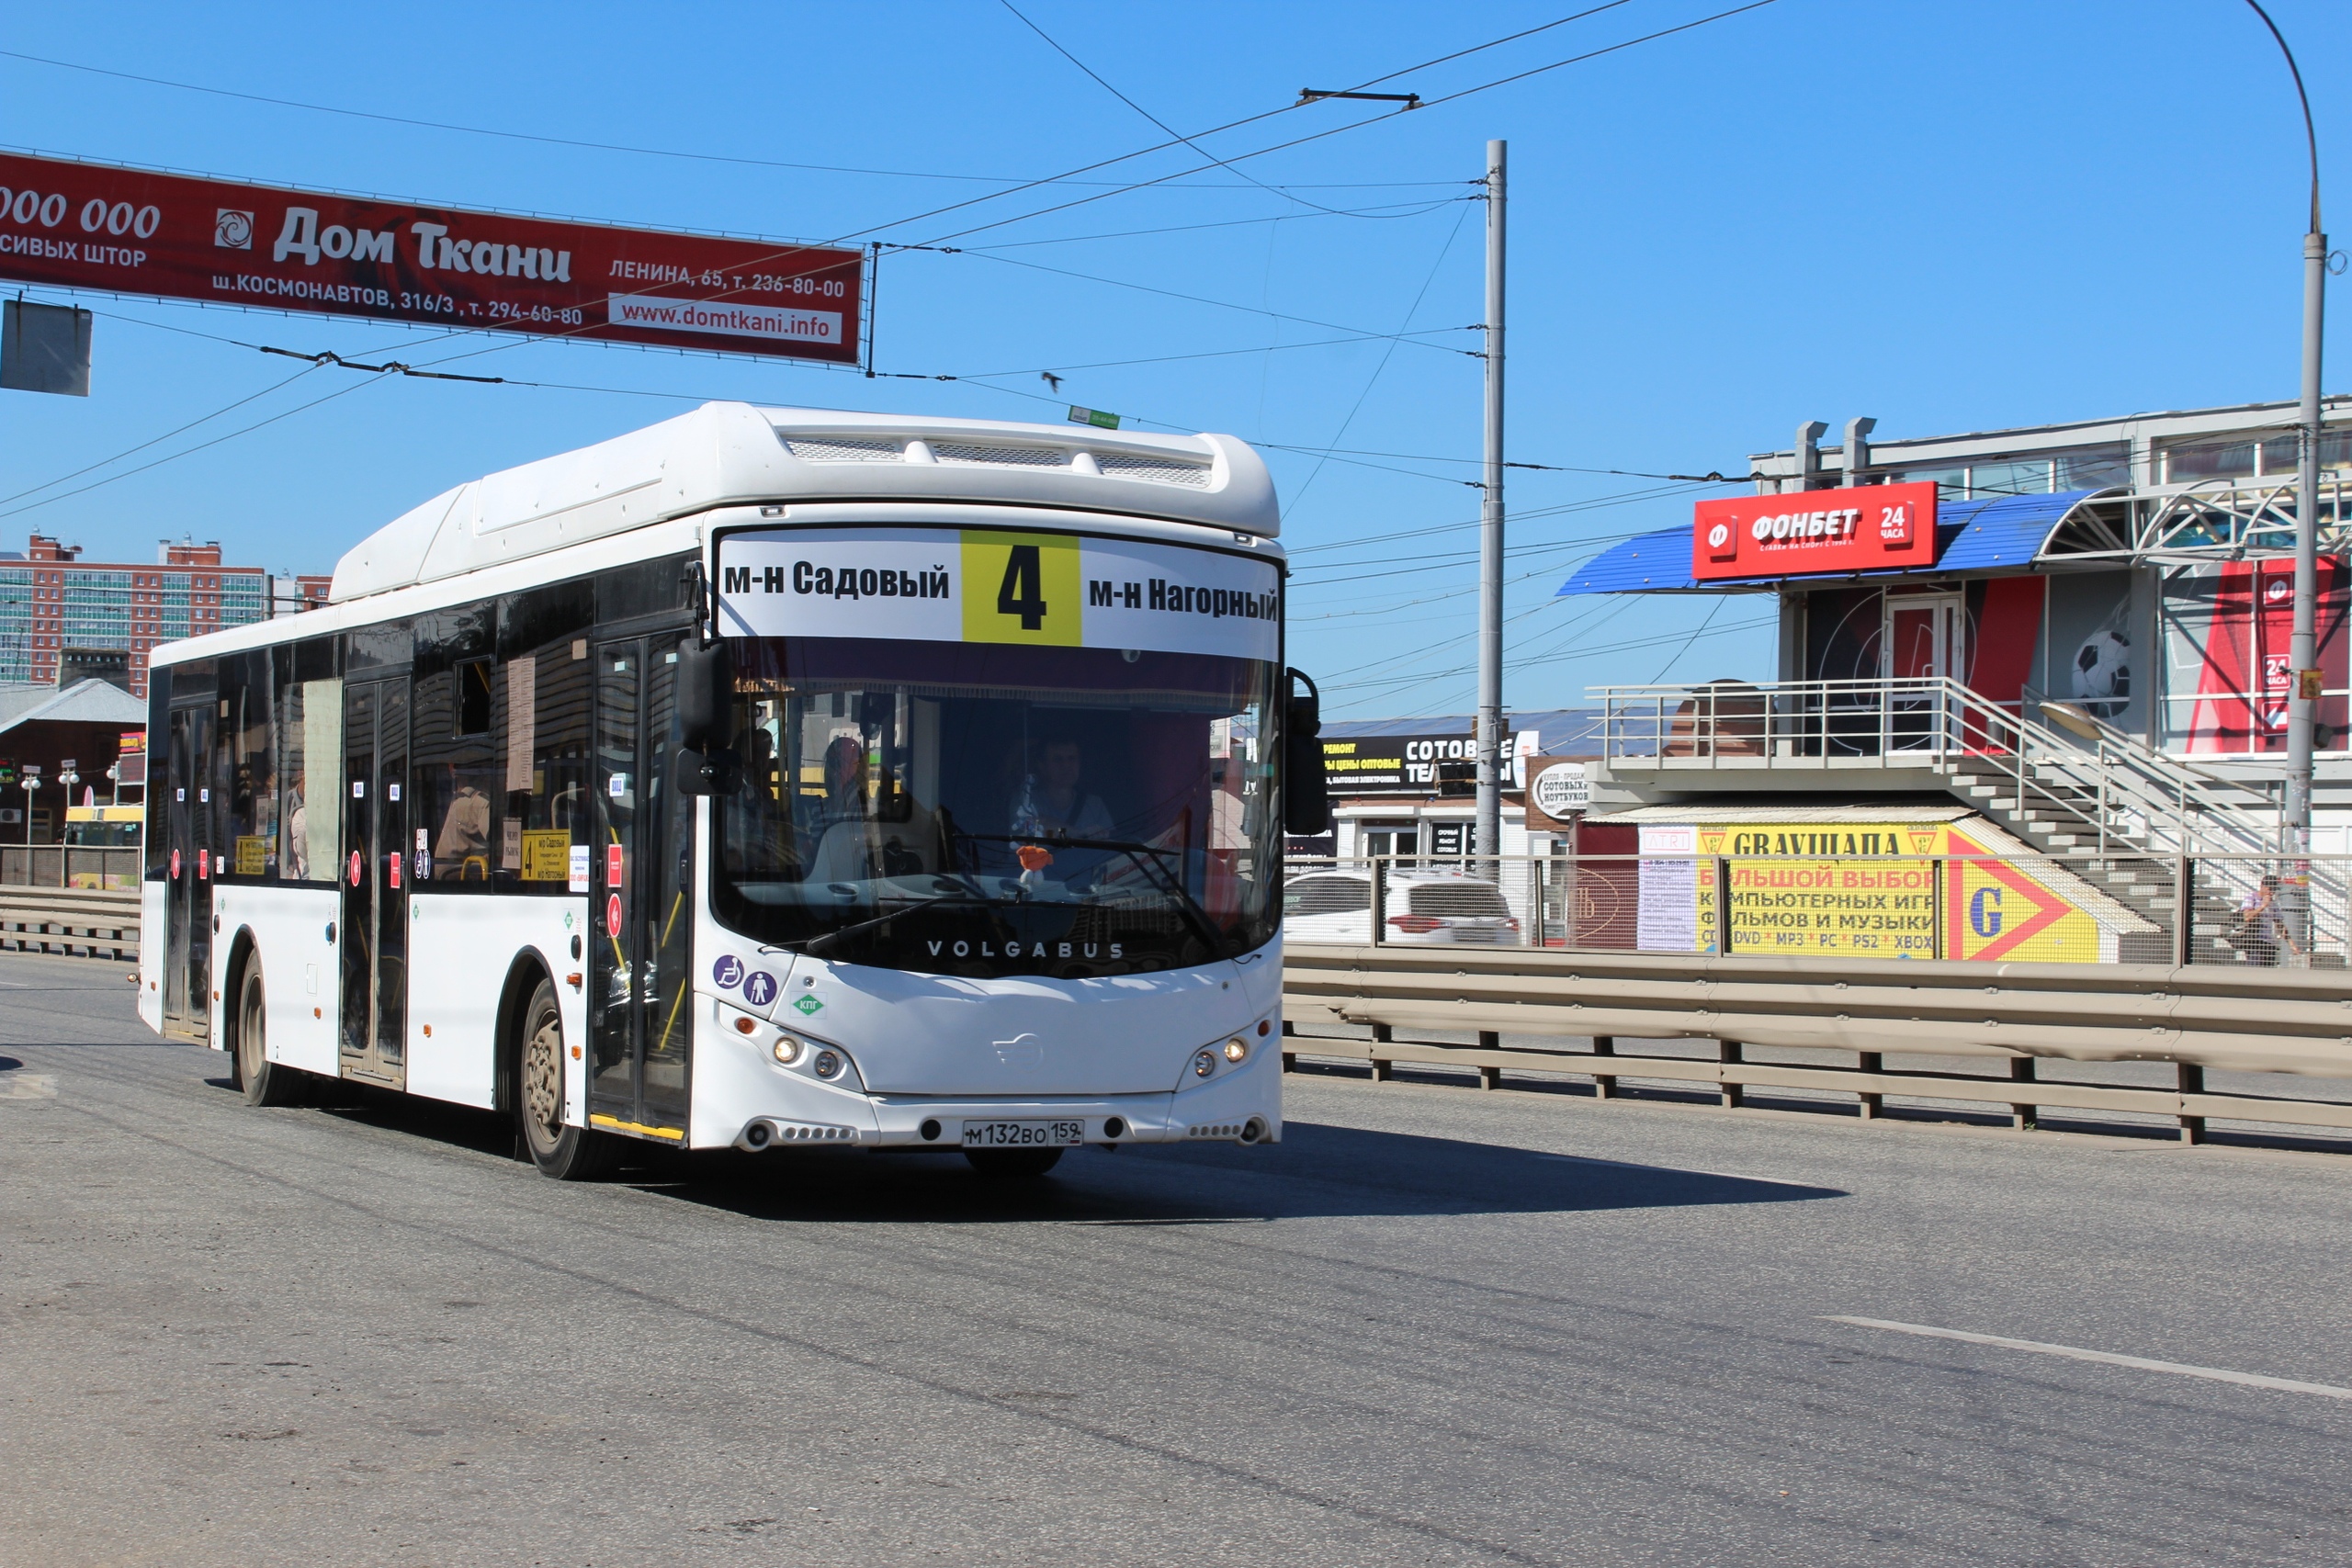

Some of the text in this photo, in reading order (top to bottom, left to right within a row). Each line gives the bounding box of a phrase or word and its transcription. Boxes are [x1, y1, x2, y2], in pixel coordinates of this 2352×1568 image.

[80, 198, 161, 239] 000
[0, 234, 146, 267] СИВЫХ ШТОР
[273, 207, 571, 283] Дом Ткани
[609, 260, 844, 298] ЛЕНИНА, 65, т. 236-80-00
[212, 275, 395, 310] ш.КОСМОНАВТОВ,
[489, 301, 582, 325] 294-60-80
[622, 305, 830, 337] www.domtkani.info
[1752, 509, 1859, 540] ФОНБЕТ
[1881, 506, 1905, 527] 24
[1708, 524, 1728, 548] Ф
[1881, 529, 1905, 538] ЧАСА
[725, 559, 950, 601] м-н Садовый
[997, 545, 1046, 630] 4
[1090, 578, 1278, 622] м-н Нагорный
[2267, 659, 2286, 676] 24
[1407, 739, 1513, 761] СОТОВЕ
[1336, 760, 1360, 771] ЦЕНЫ
[1361, 759, 1401, 769] ОПТОВЫЕ
[1544, 781, 1583, 791] СОТОВЫХ
[1544, 792, 1589, 801] НОУТБУКОВ
[526, 840, 532, 877] 4
[1700, 865, 1832, 888] БЛЬШОЙ
[1701, 892, 1886, 909] КМПЬЮТЕРНЫХ
[1971, 887, 2002, 937] G
[1702, 911, 1808, 927] ФЛЬМОВ
[1816, 914, 1830, 929] И
[928, 940, 1123, 959] VOLGABUS
[1734, 931, 1760, 944] DVD
[1776, 932, 1804, 946] MP3
[1820, 933, 1837, 946] PC
[1853, 934, 1878, 948] PS2
[1894, 935, 1934, 949] XBOX
[800, 999, 818, 1010] КПГ
[1051, 1123, 1079, 1138] 159
